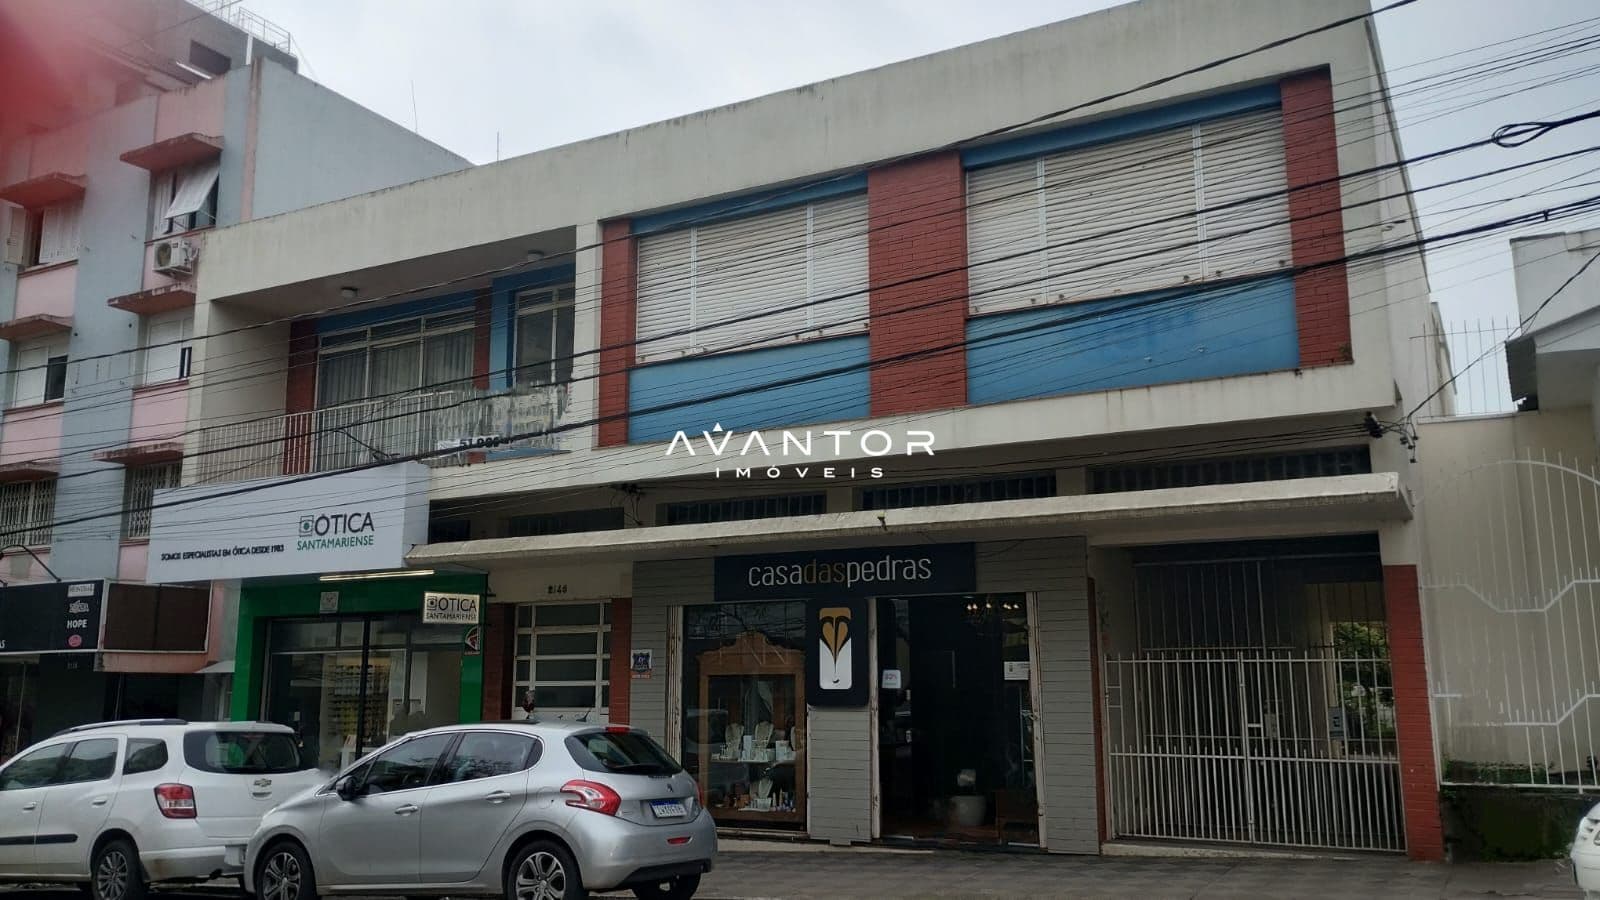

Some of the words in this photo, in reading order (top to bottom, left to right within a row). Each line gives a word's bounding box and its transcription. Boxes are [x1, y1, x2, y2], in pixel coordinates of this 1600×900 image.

[297, 535, 374, 551] SANTAMARIENSE
[161, 552, 181, 561] SOMOS
[183, 549, 221, 560] ESPECIALISTAS
[222, 549, 231, 557] EM
[251, 546, 270, 554] DESDE
[748, 555, 932, 588] casadaspedras
[67, 619, 88, 629] HOPE
